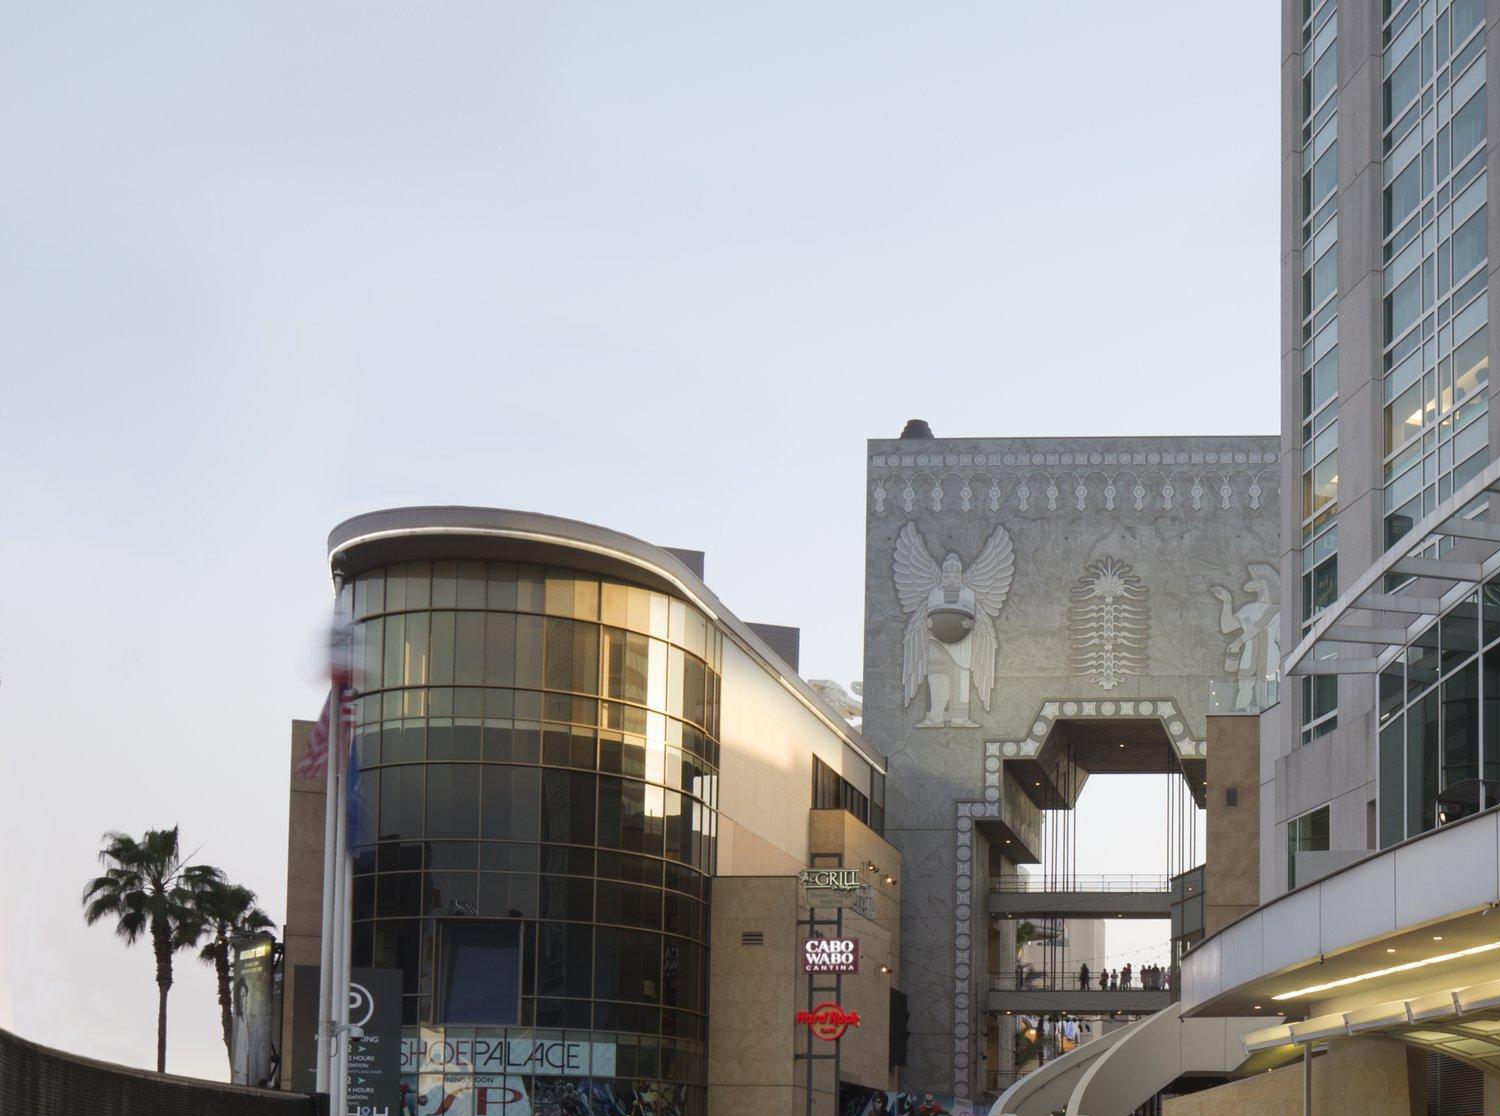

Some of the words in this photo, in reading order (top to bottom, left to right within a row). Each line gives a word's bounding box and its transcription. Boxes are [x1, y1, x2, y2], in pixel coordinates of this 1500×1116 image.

[815, 871, 860, 886] GRILL
[805, 940, 854, 953] CABO
[805, 952, 854, 965] WABO
